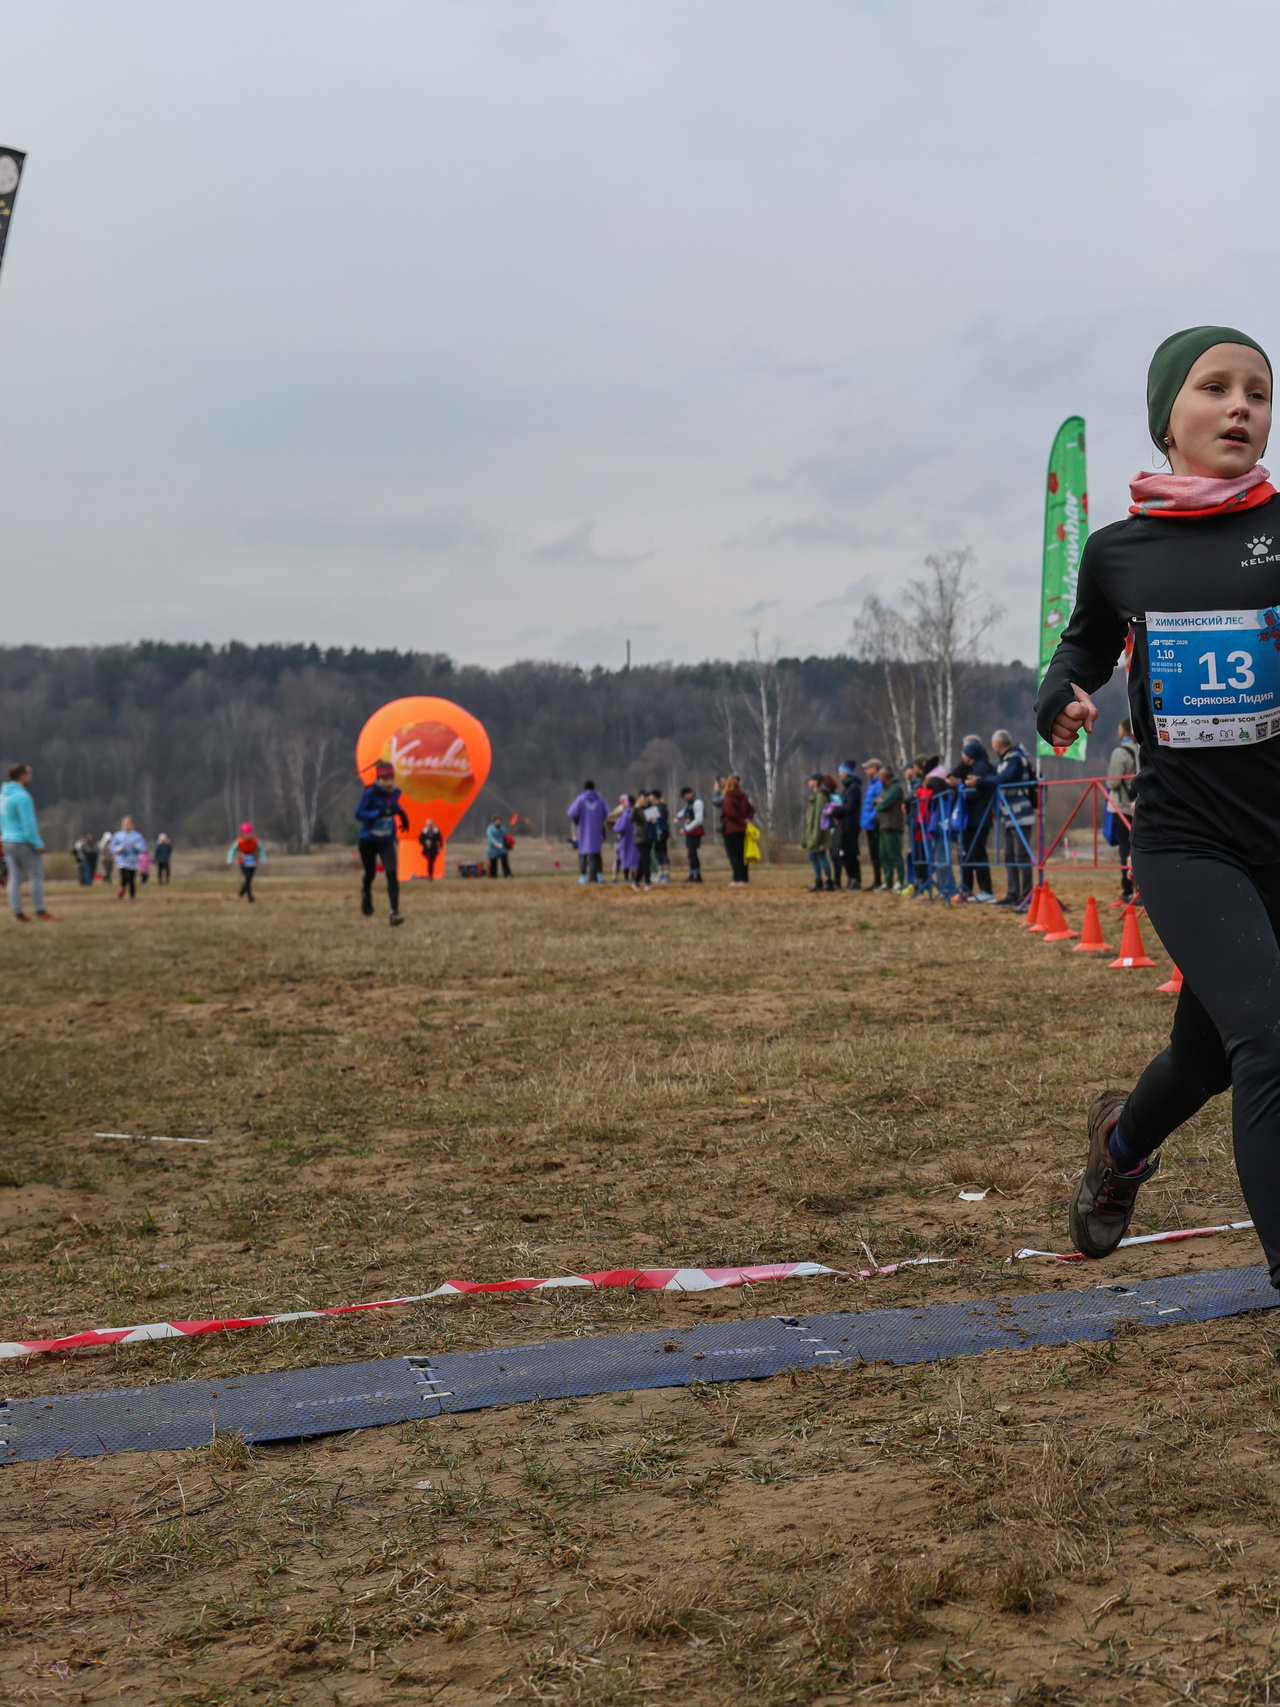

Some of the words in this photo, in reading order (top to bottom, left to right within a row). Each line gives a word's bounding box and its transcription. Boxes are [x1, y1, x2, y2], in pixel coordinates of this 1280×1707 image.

[1155, 615, 1223, 626] ХИМКИНСКИЙ
[1224, 616, 1244, 625] ЛЕС
[1156, 649, 1175, 661] 1,10
[1198, 650, 1256, 691] 13
[1183, 695, 1237, 708] Серякова
[1238, 691, 1274, 705] Лидия
